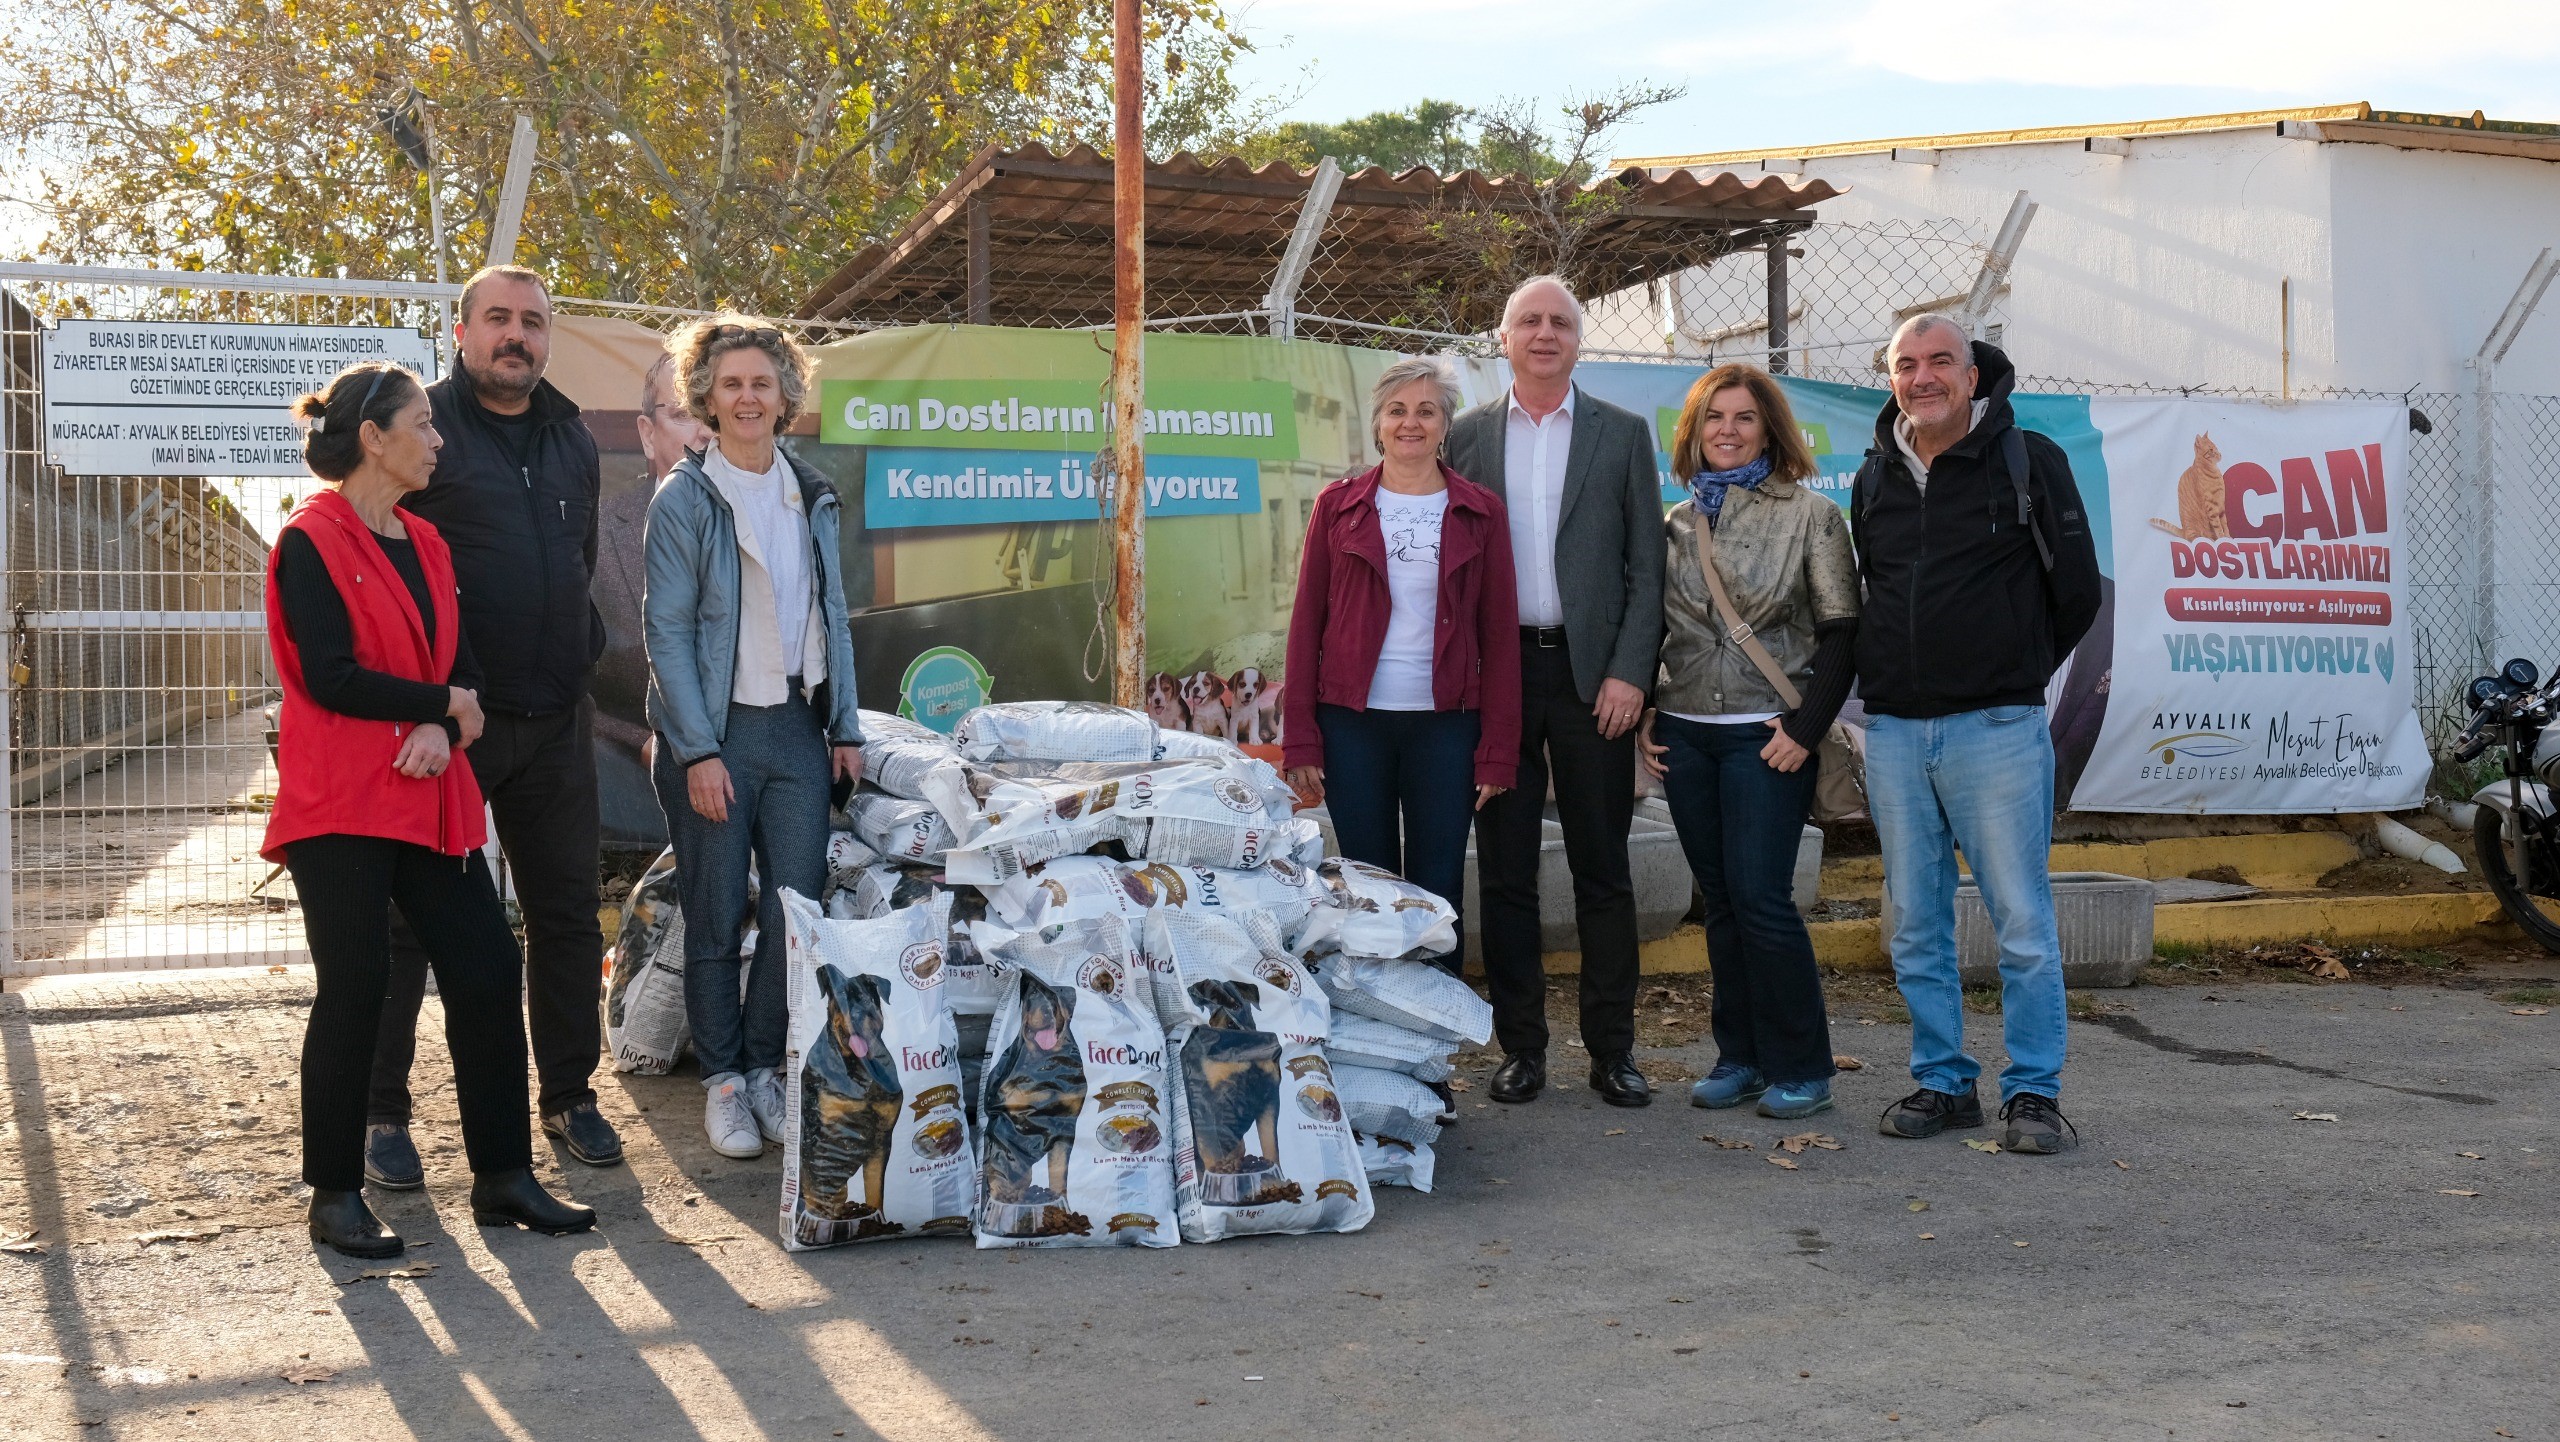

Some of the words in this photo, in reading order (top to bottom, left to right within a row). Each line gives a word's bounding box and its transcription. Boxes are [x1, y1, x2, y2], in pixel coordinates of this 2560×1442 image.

[89, 332, 135, 348] BURASI
[138, 330, 158, 349] BİR
[161, 333, 207, 350] DEVLET
[211, 335, 286, 352] KURUMUNUN
[289, 333, 388, 354] HİMAYESİNDEDİR.
[53, 351, 127, 371] ZİYARETLER
[130, 353, 167, 372] MESAİ
[170, 354, 228, 373] SAATLERİ
[230, 354, 296, 378] İÇERİSİNDE
[300, 360, 314, 375] VE
[130, 375, 211, 395] GÖZETİMİNDE
[843, 397, 911, 432] Can
[918, 398, 1096, 434] Dostların
[52, 420, 120, 440] MÜRACAAT
[129, 424, 178, 441] AYVALIK
[182, 422, 250, 441] BELEDİYESİ
[152, 444, 184, 466] (MAVİ
[187, 444, 215, 463] BİNA
[230, 445, 270, 464] TEDAVİ
[887, 467, 1053, 500] Kendimiz
[2170, 541, 2391, 583] DOSTLARIMIZI
[2182, 596, 2306, 616] Kısırlaştırıyoruz
[2318, 599, 2382, 618] Aşılıyoruz
[2162, 632, 2371, 682] YAŞATIYORUZ
[917, 676, 970, 701] Kompost
[2153, 713, 2251, 730] AYVALIK
[2141, 765, 2246, 780] BELEDİYESİ
[2253, 763, 2298, 783] Ayvalık
[2300, 763, 2357, 782] Belediye
[2367, 761, 2403, 782] Başkanı
[948, 968, 958, 978] 15
[909, 1163, 932, 1174] Lamb
[1093, 1156, 1117, 1164] Lamb
[1235, 1208, 1244, 1218] 15
